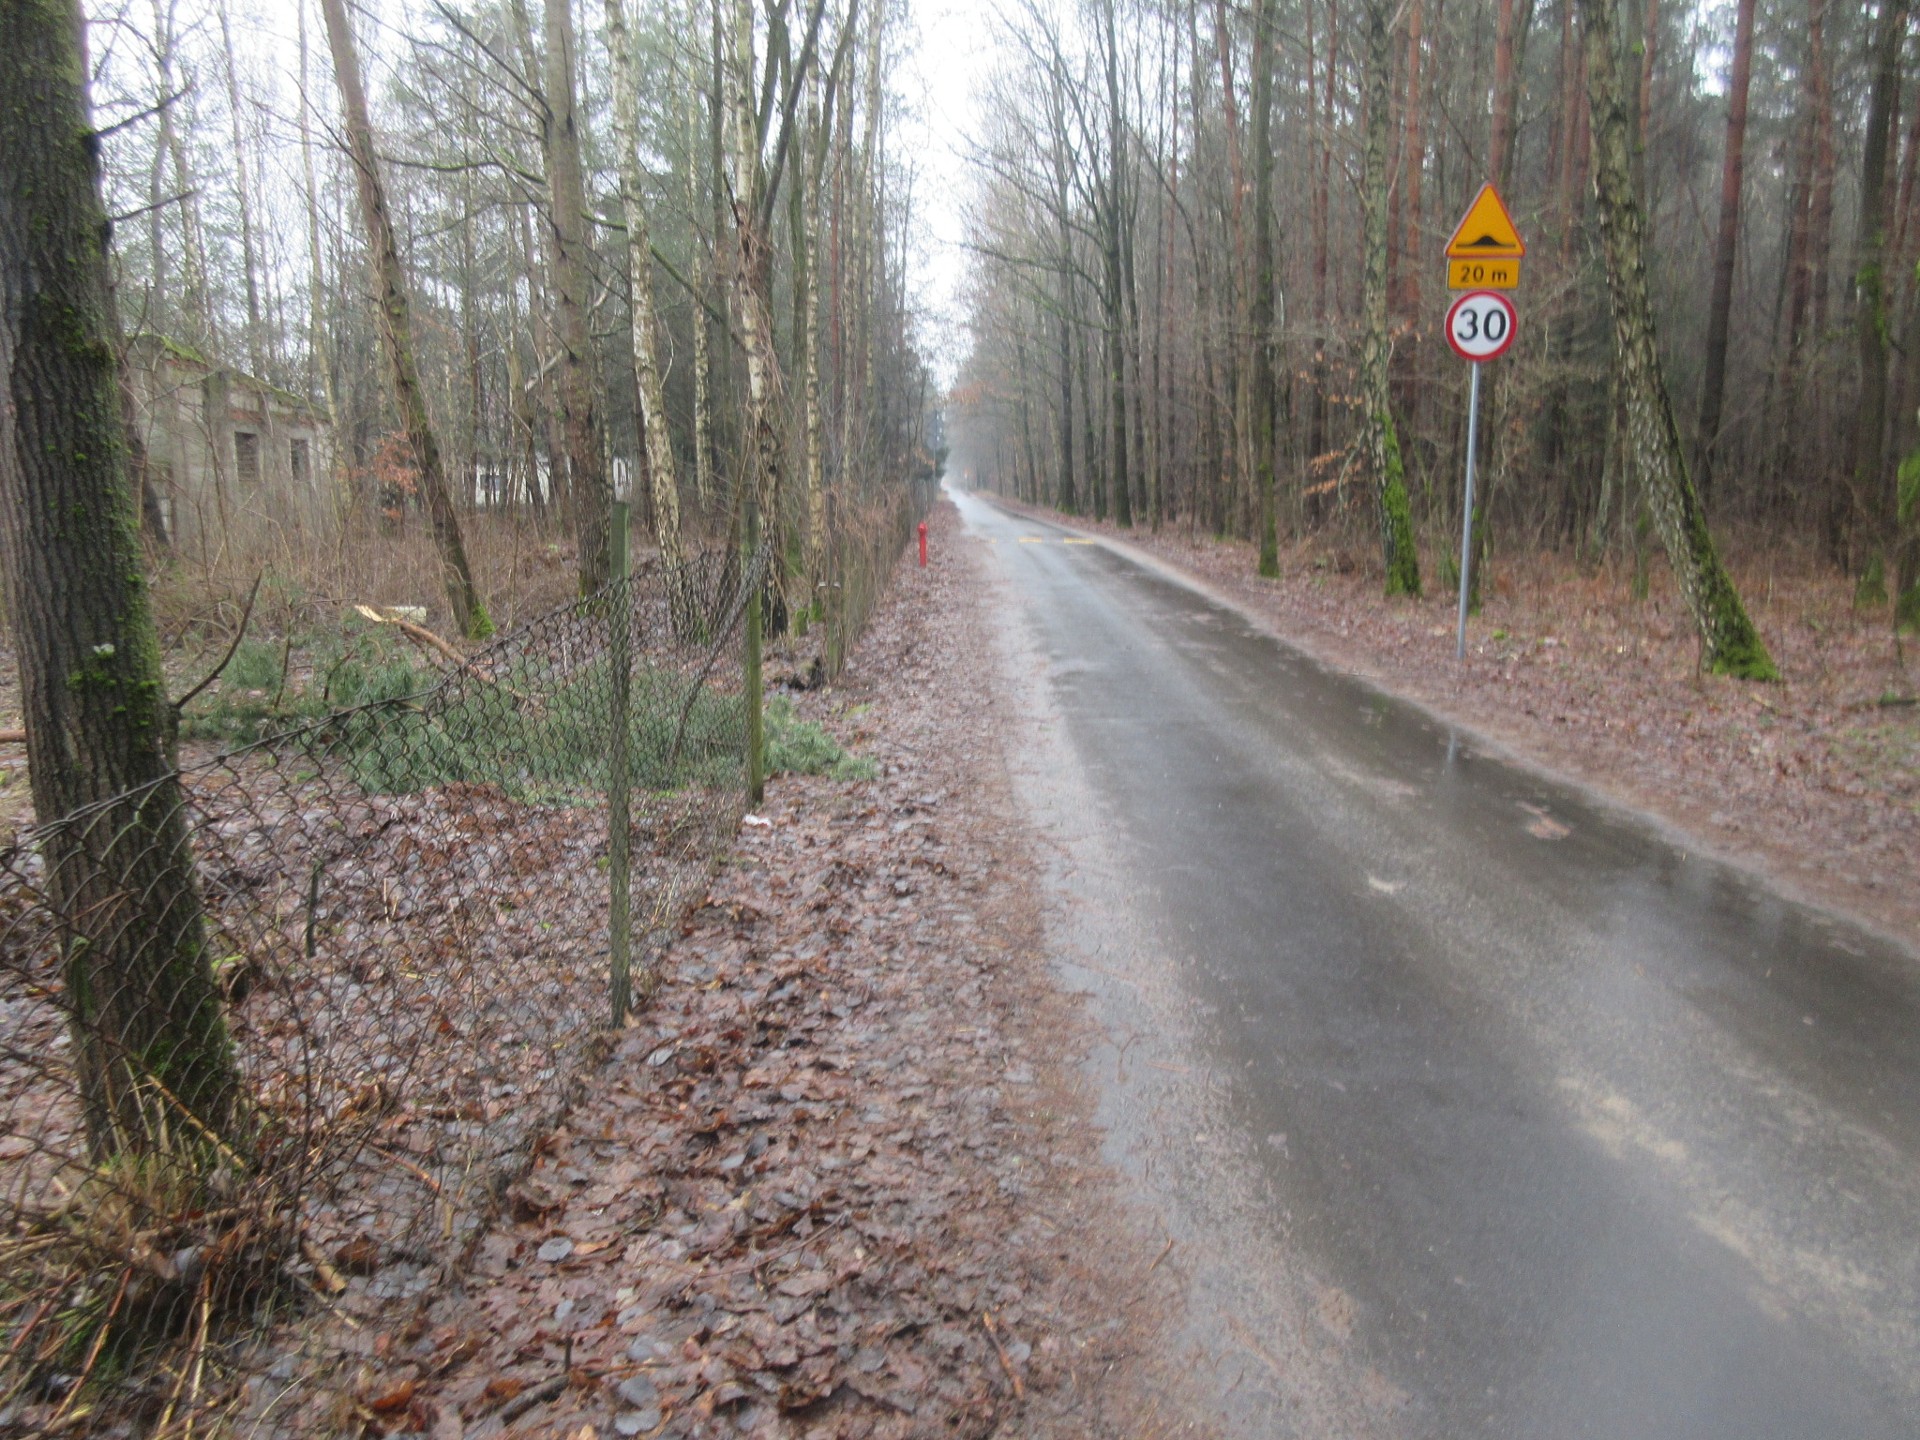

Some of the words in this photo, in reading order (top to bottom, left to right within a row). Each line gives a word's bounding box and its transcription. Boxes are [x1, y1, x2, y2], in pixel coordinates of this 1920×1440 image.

[1460, 265, 1484, 283] 20
[1491, 269, 1507, 282] m
[1457, 308, 1506, 341] 30
